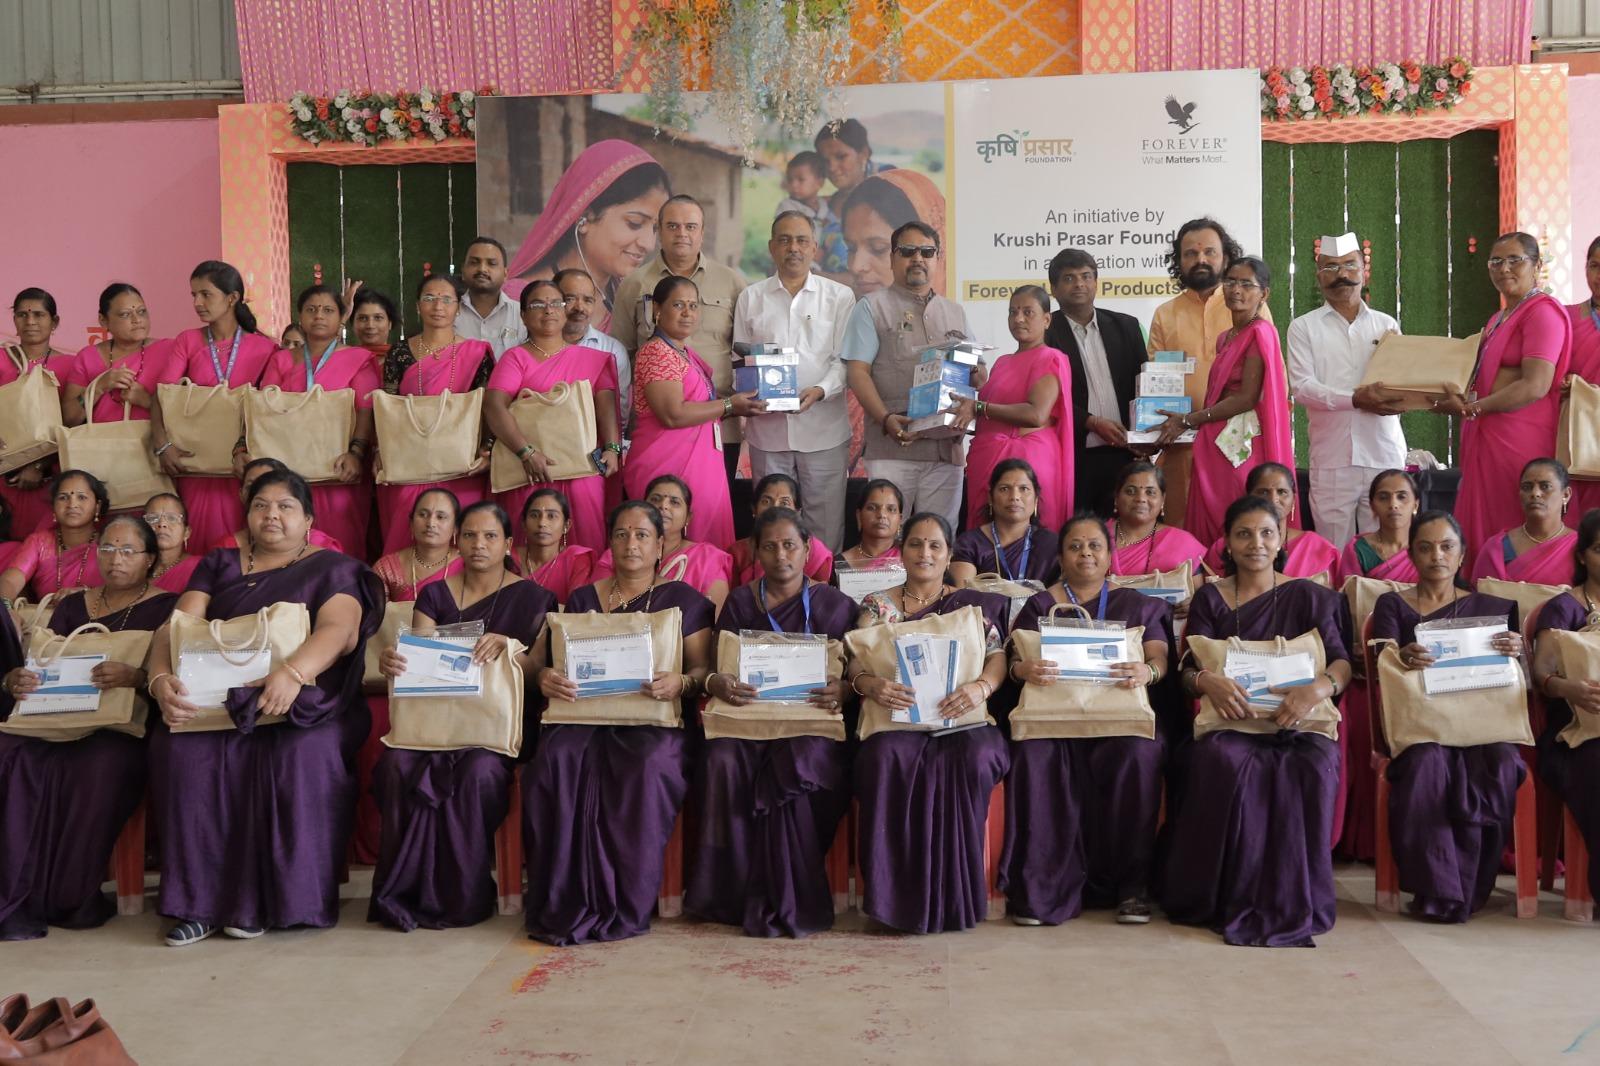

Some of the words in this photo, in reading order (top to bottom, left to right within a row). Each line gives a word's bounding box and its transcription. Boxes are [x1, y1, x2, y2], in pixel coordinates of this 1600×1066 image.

[976, 134, 1019, 163] कृषि
[1023, 139, 1073, 156] प्रसार
[1024, 156, 1072, 164] FOUNDATION
[1142, 155, 1164, 165] What
[1165, 155, 1200, 164] Matters
[1045, 209, 1067, 224] An
[1073, 209, 1140, 223] initiative
[1146, 208, 1165, 226] by
[993, 232, 1051, 247] Krushi
[1057, 231, 1114, 246] Prasar
[1120, 230, 1176, 245] Found
[1024, 256, 1037, 270] in
[1101, 280, 1182, 296] Products
